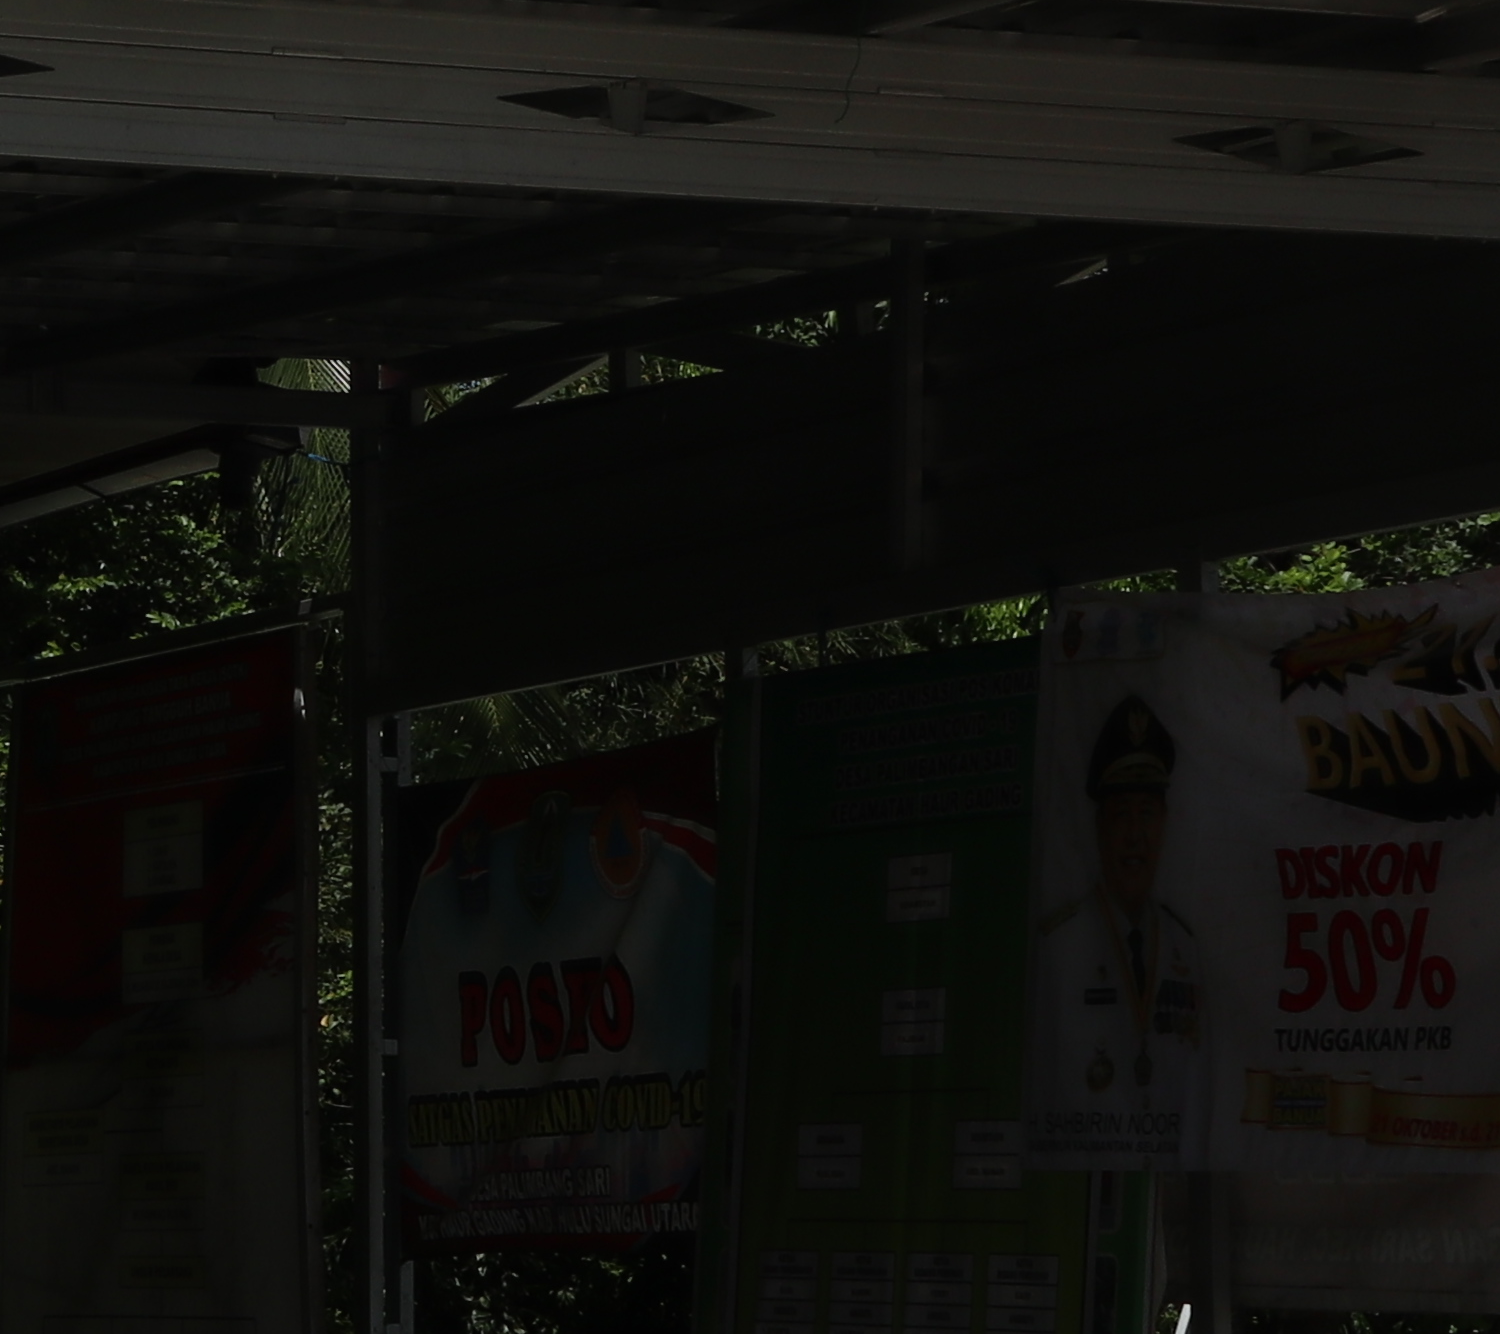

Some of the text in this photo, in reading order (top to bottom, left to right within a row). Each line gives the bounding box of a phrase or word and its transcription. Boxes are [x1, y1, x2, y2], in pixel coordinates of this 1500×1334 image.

[865, 678, 955, 713] ORGANISASI
[958, 674, 988, 701] POS
[941, 711, 987, 739] COVID
[835, 765, 871, 789] DESA
[983, 745, 1018, 772] SARI
[831, 783, 1022, 824] KECAMATAN HAUR GADING
[1275, 840, 1443, 899] DISKON
[1278, 908, 1456, 1012] 50%
[1275, 1026, 1452, 1052] TUNGGAKAN PKB
[602, 1070, 705, 1132] COVID-19
[1045, 1111, 1180, 1135] SAHBIRIN NOOR
[1391, 1115, 1458, 1142] OKTOBER
[500, 1165, 611, 1200] PALIMBANG SARI
